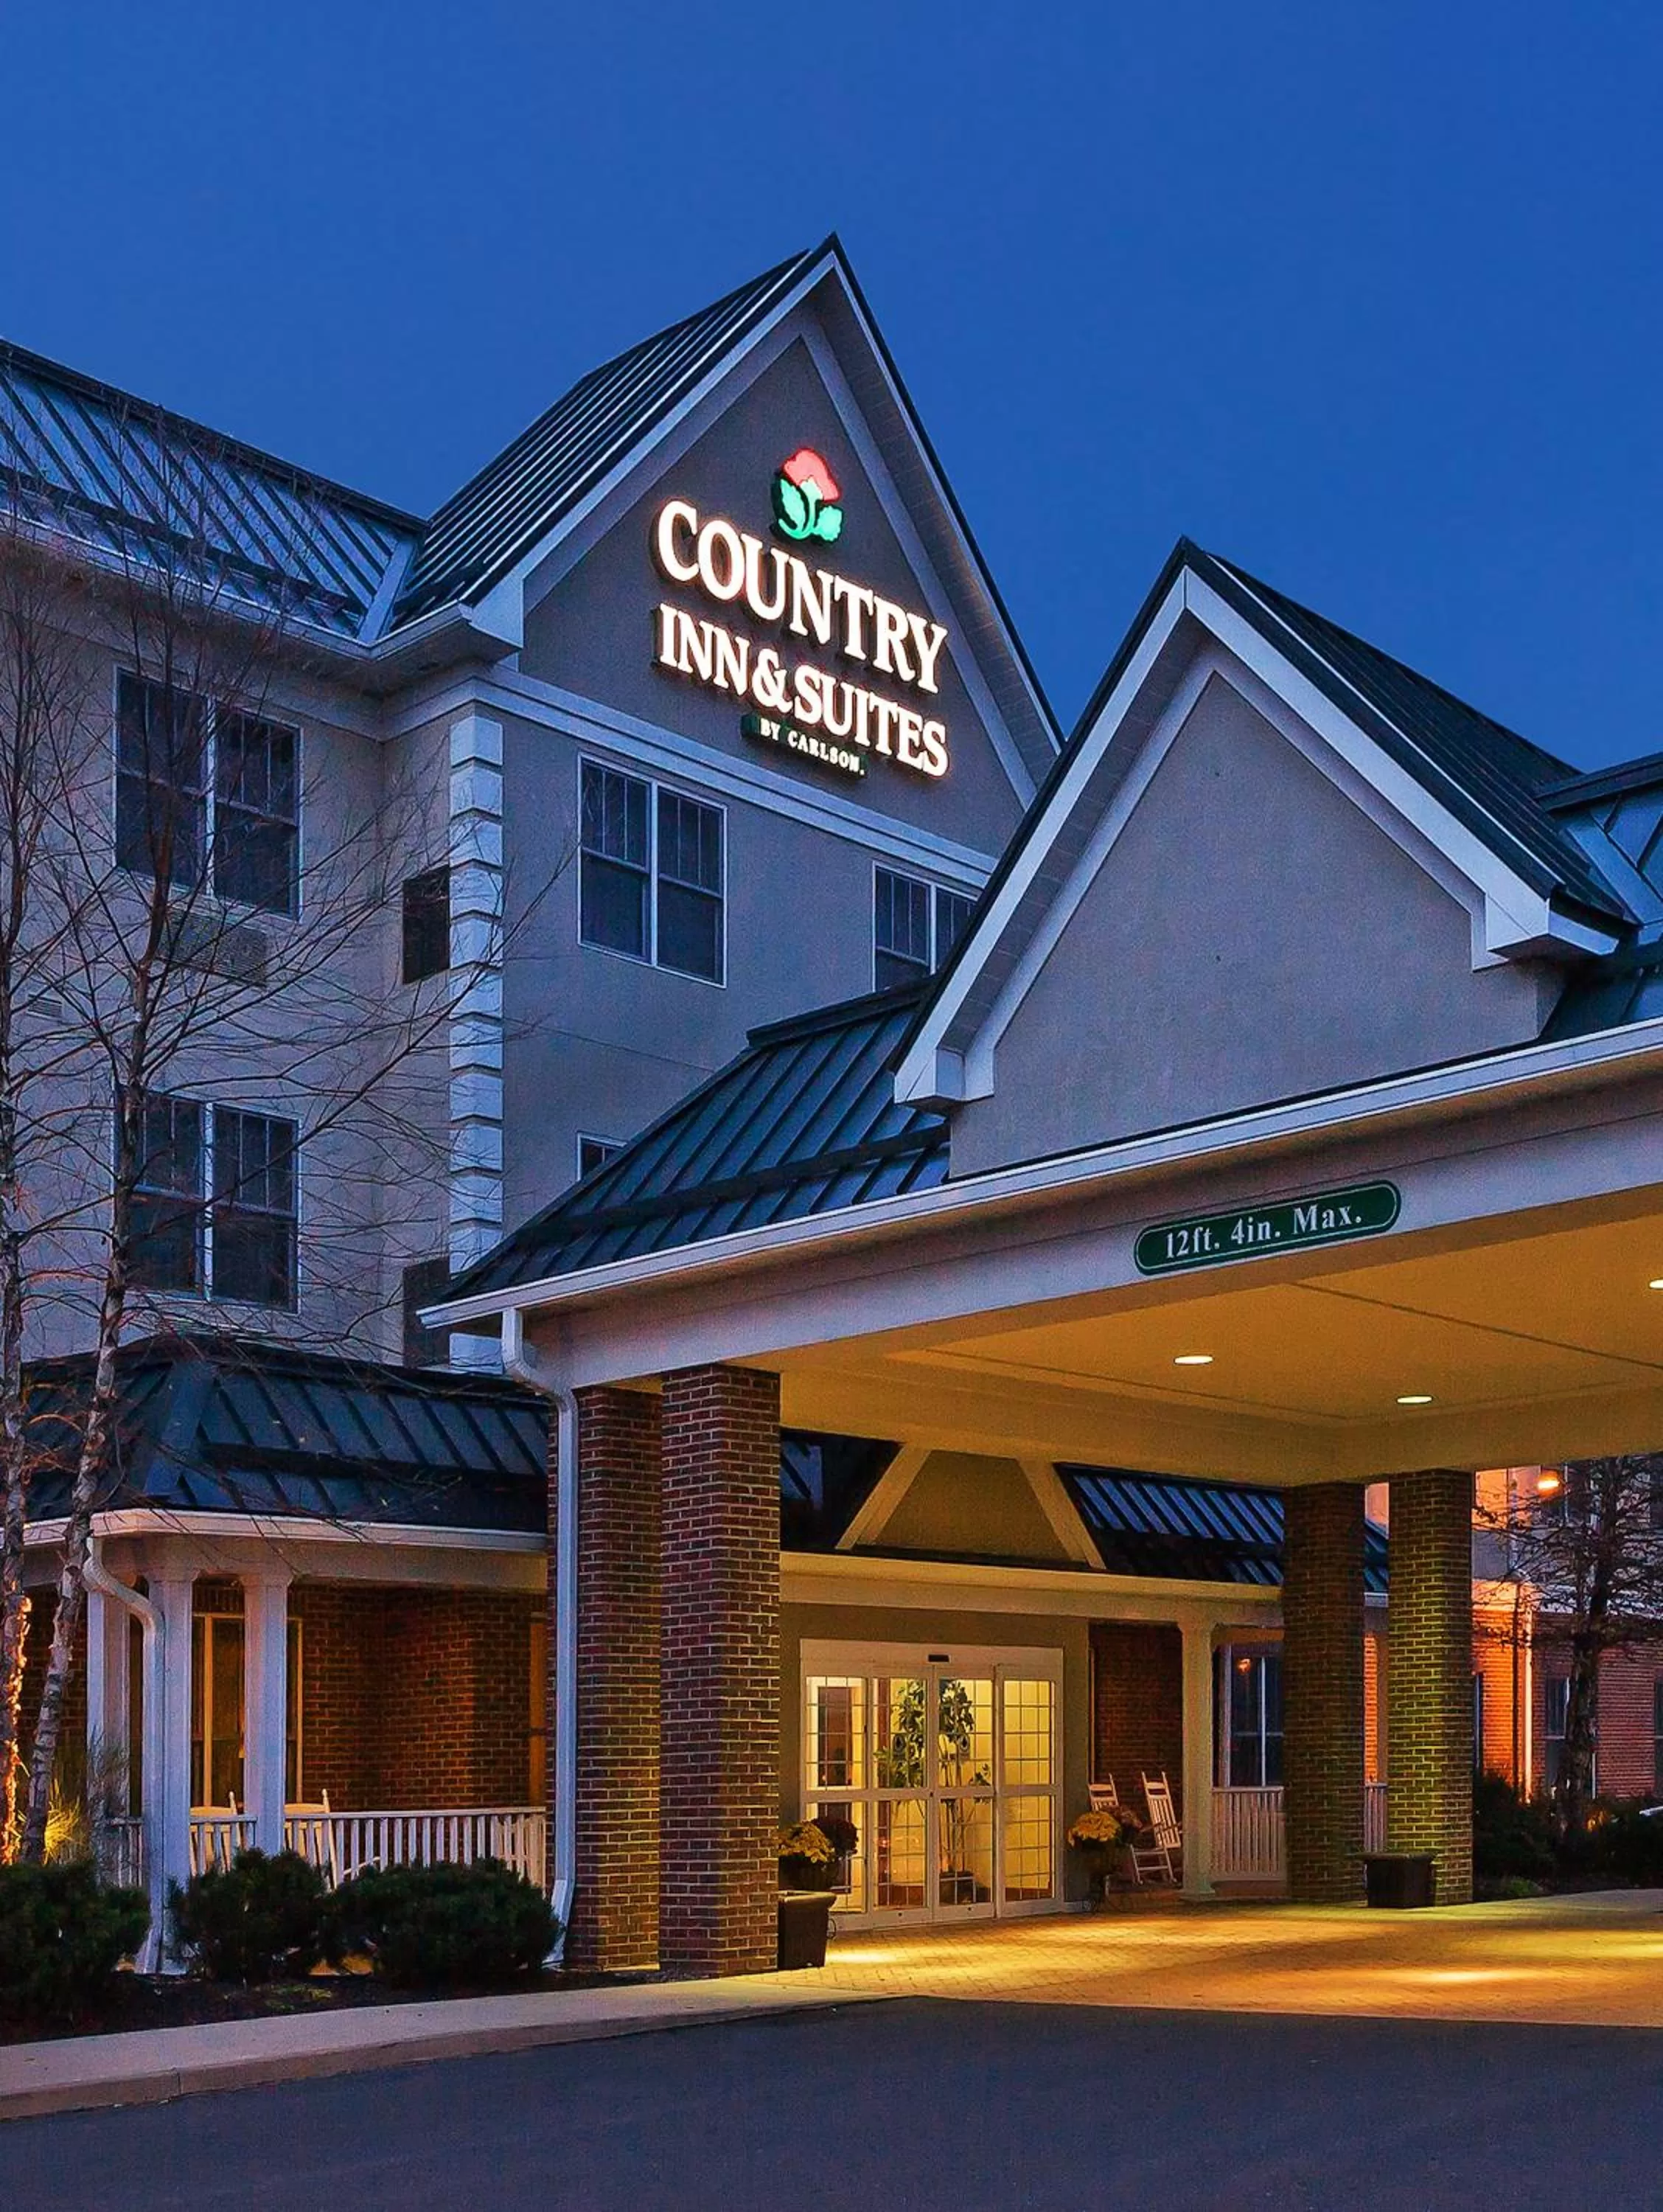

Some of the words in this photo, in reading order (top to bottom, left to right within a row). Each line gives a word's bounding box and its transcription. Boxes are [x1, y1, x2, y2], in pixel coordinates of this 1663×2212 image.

[658, 501, 948, 694] COUNTRY
[760, 717, 780, 741] BY
[1165, 1227, 1220, 1259] 12ft.
[1230, 1216, 1280, 1245] 4in.
[1293, 1203, 1362, 1235] Max.
